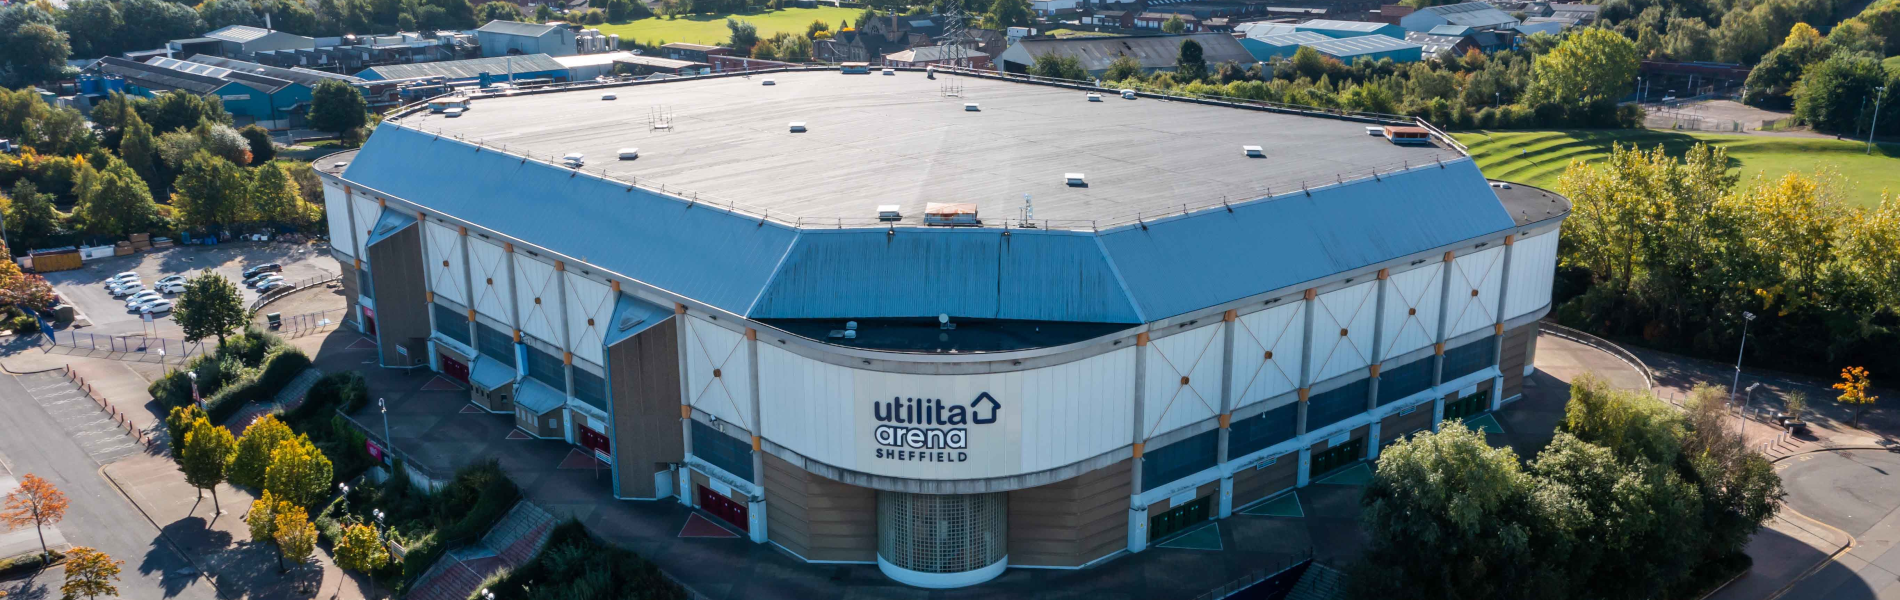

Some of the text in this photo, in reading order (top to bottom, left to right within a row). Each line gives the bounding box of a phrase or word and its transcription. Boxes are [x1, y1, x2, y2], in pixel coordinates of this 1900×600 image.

[874, 396, 967, 425] utilita
[875, 424, 967, 449] arena
[876, 448, 968, 462] SHEFFIELD
